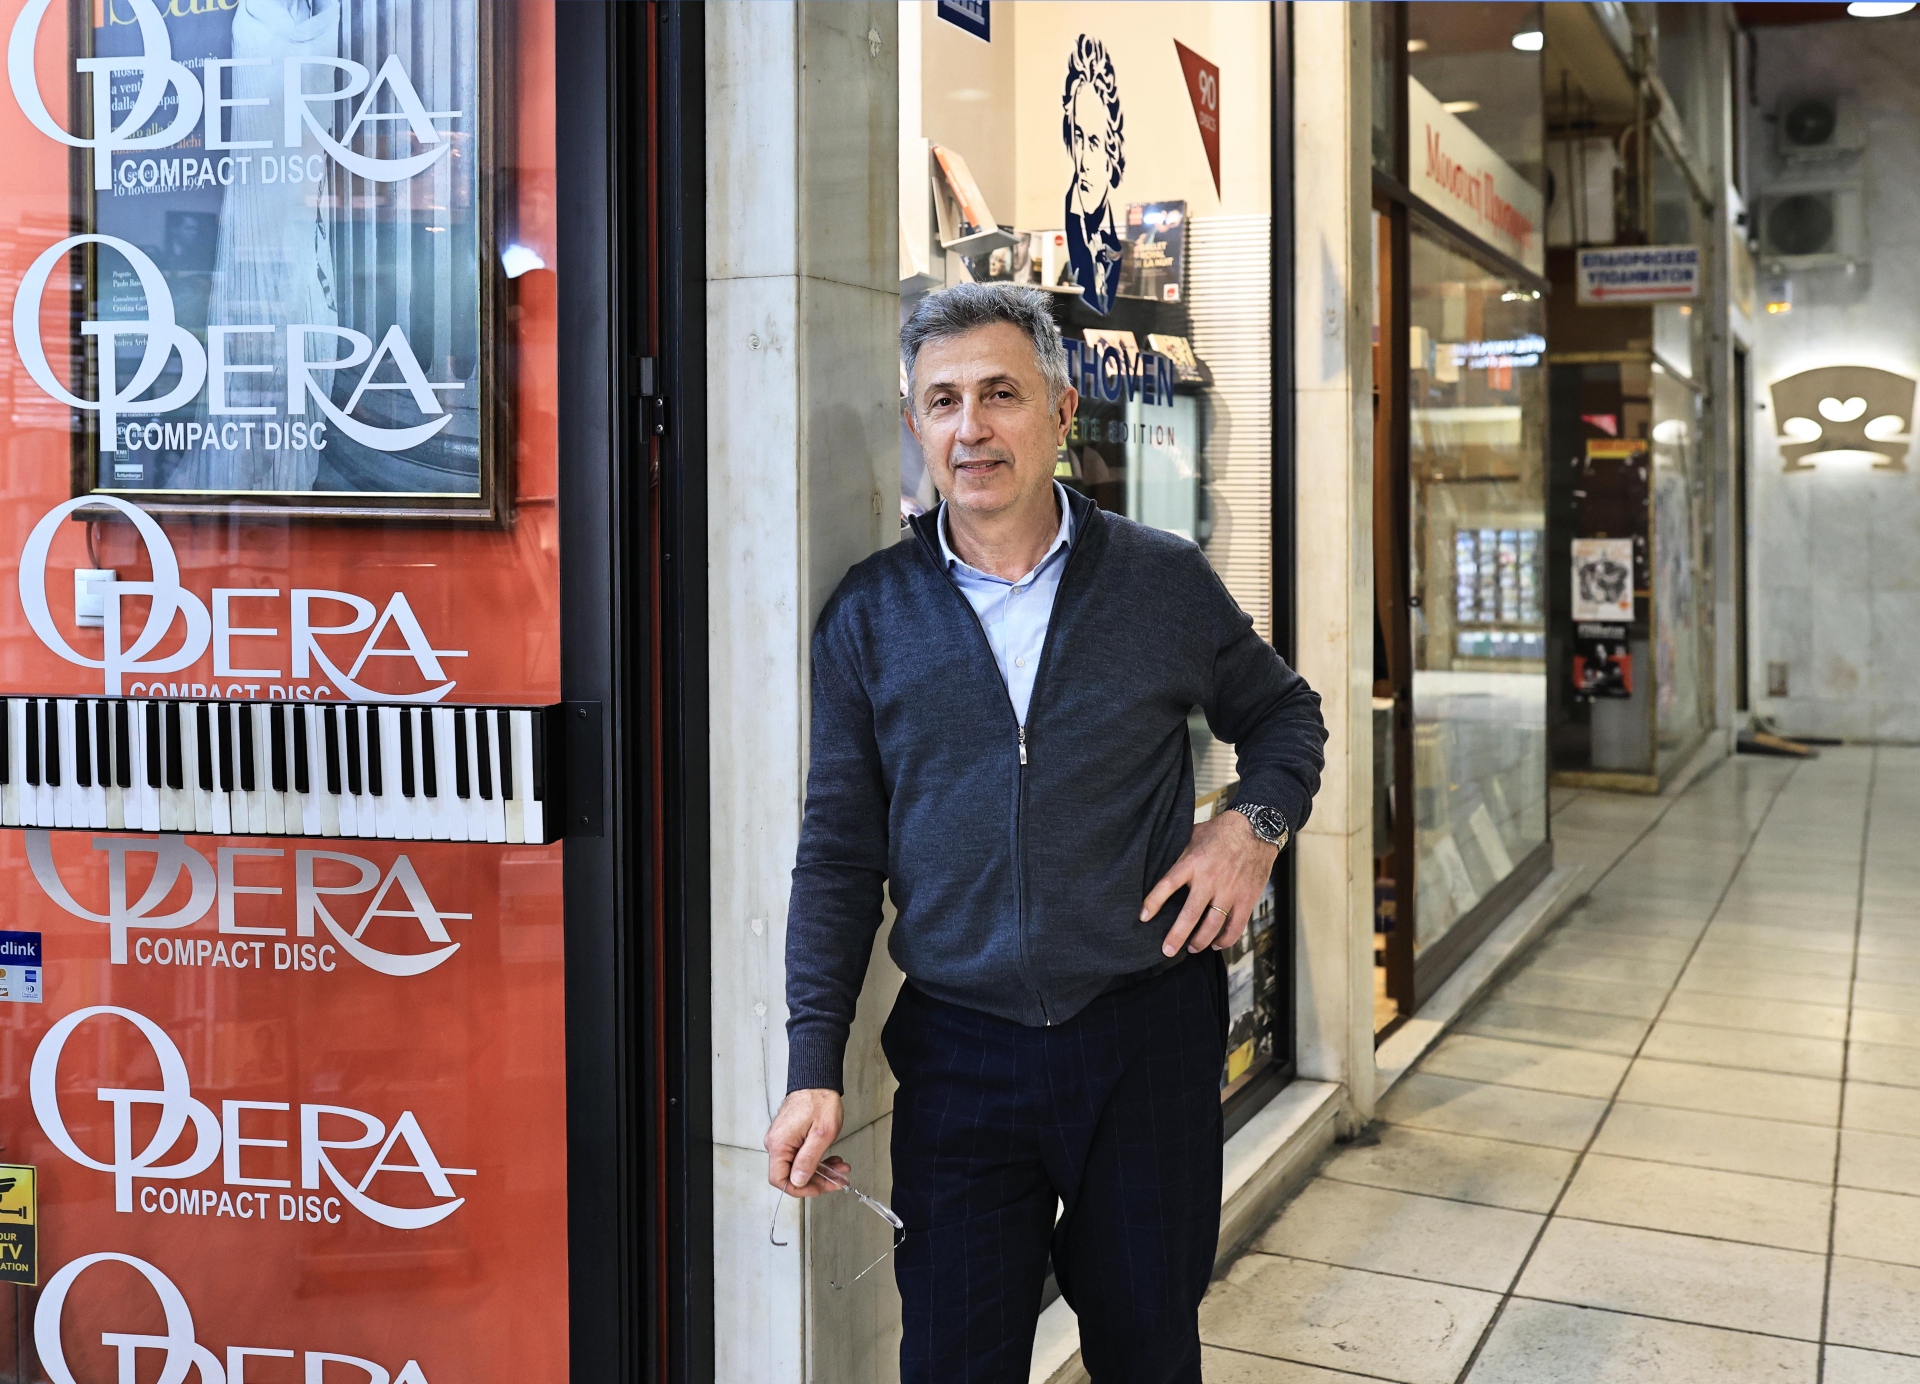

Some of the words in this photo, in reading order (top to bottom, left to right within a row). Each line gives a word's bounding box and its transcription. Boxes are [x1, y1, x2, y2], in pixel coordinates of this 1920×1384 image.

[8, 0, 462, 189] OPERA
[111, 85, 117, 94] a
[1199, 69, 1217, 111] 90
[113, 183, 125, 197] 16
[120, 156, 252, 188] COMPACT
[261, 154, 324, 184] DISC
[12, 233, 466, 452] OPERA
[125, 422, 260, 452] COMPACT
[265, 421, 327, 451] DISC
[1107, 420, 1175, 446] EDITION
[19, 495, 468, 702] OPERA
[25, 830, 472, 977] OPERA
[135, 937, 265, 970] COMPACT
[274, 941, 337, 973] DISC
[29, 1005, 477, 1230] OPERA
[140, 1187, 271, 1220] COMPACT
[279, 1193, 341, 1225] DISC
